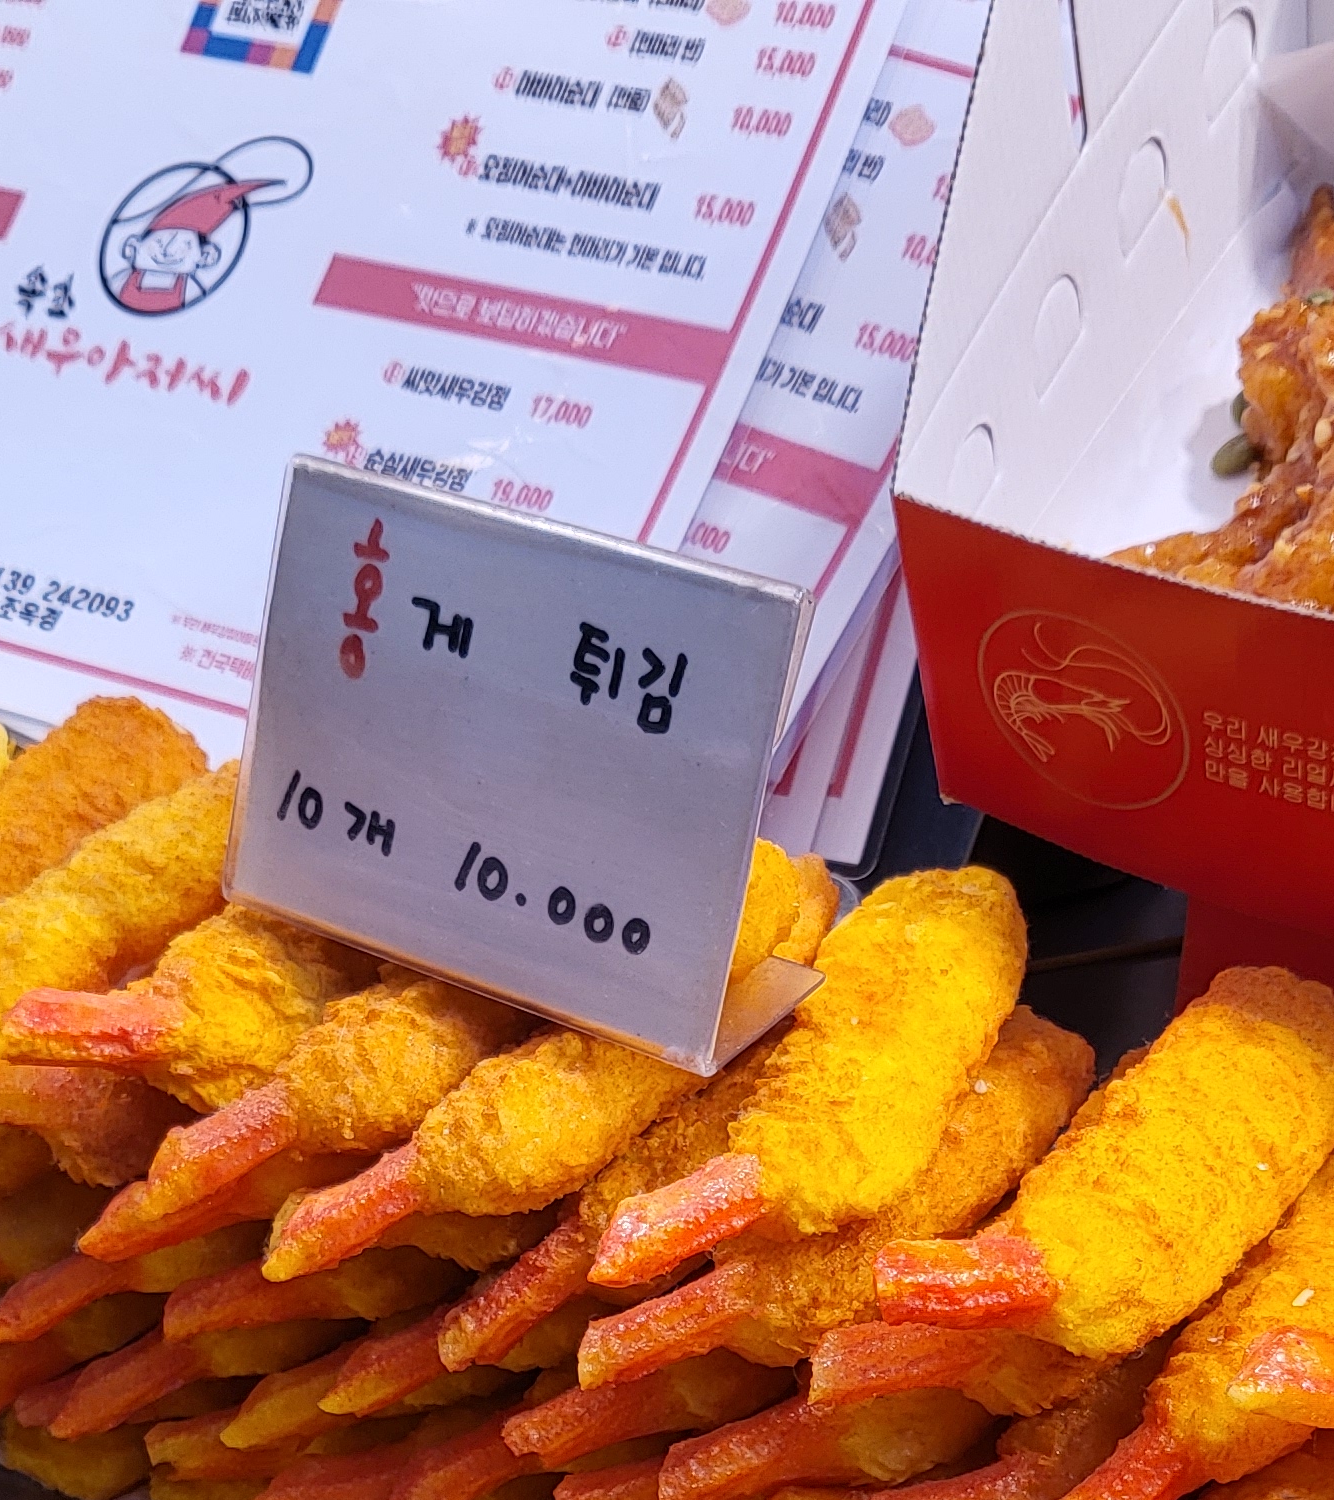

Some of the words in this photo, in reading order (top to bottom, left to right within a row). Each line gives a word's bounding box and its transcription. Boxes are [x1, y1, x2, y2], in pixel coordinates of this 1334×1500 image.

[756, 46, 817, 77] 15,000
[731, 105, 793, 137] 10,000
[693, 192, 757, 228] 15,000
[531, 393, 593, 429] 17,000
[492, 478, 554, 512] 19,000
[43, 580, 135, 622] 242093
[570, 622, 688, 735] 튀김
[1203, 710, 1246, 741] 우리
[1204, 736, 1272, 772] 싱싱한
[1205, 759, 1249, 790] 만을
